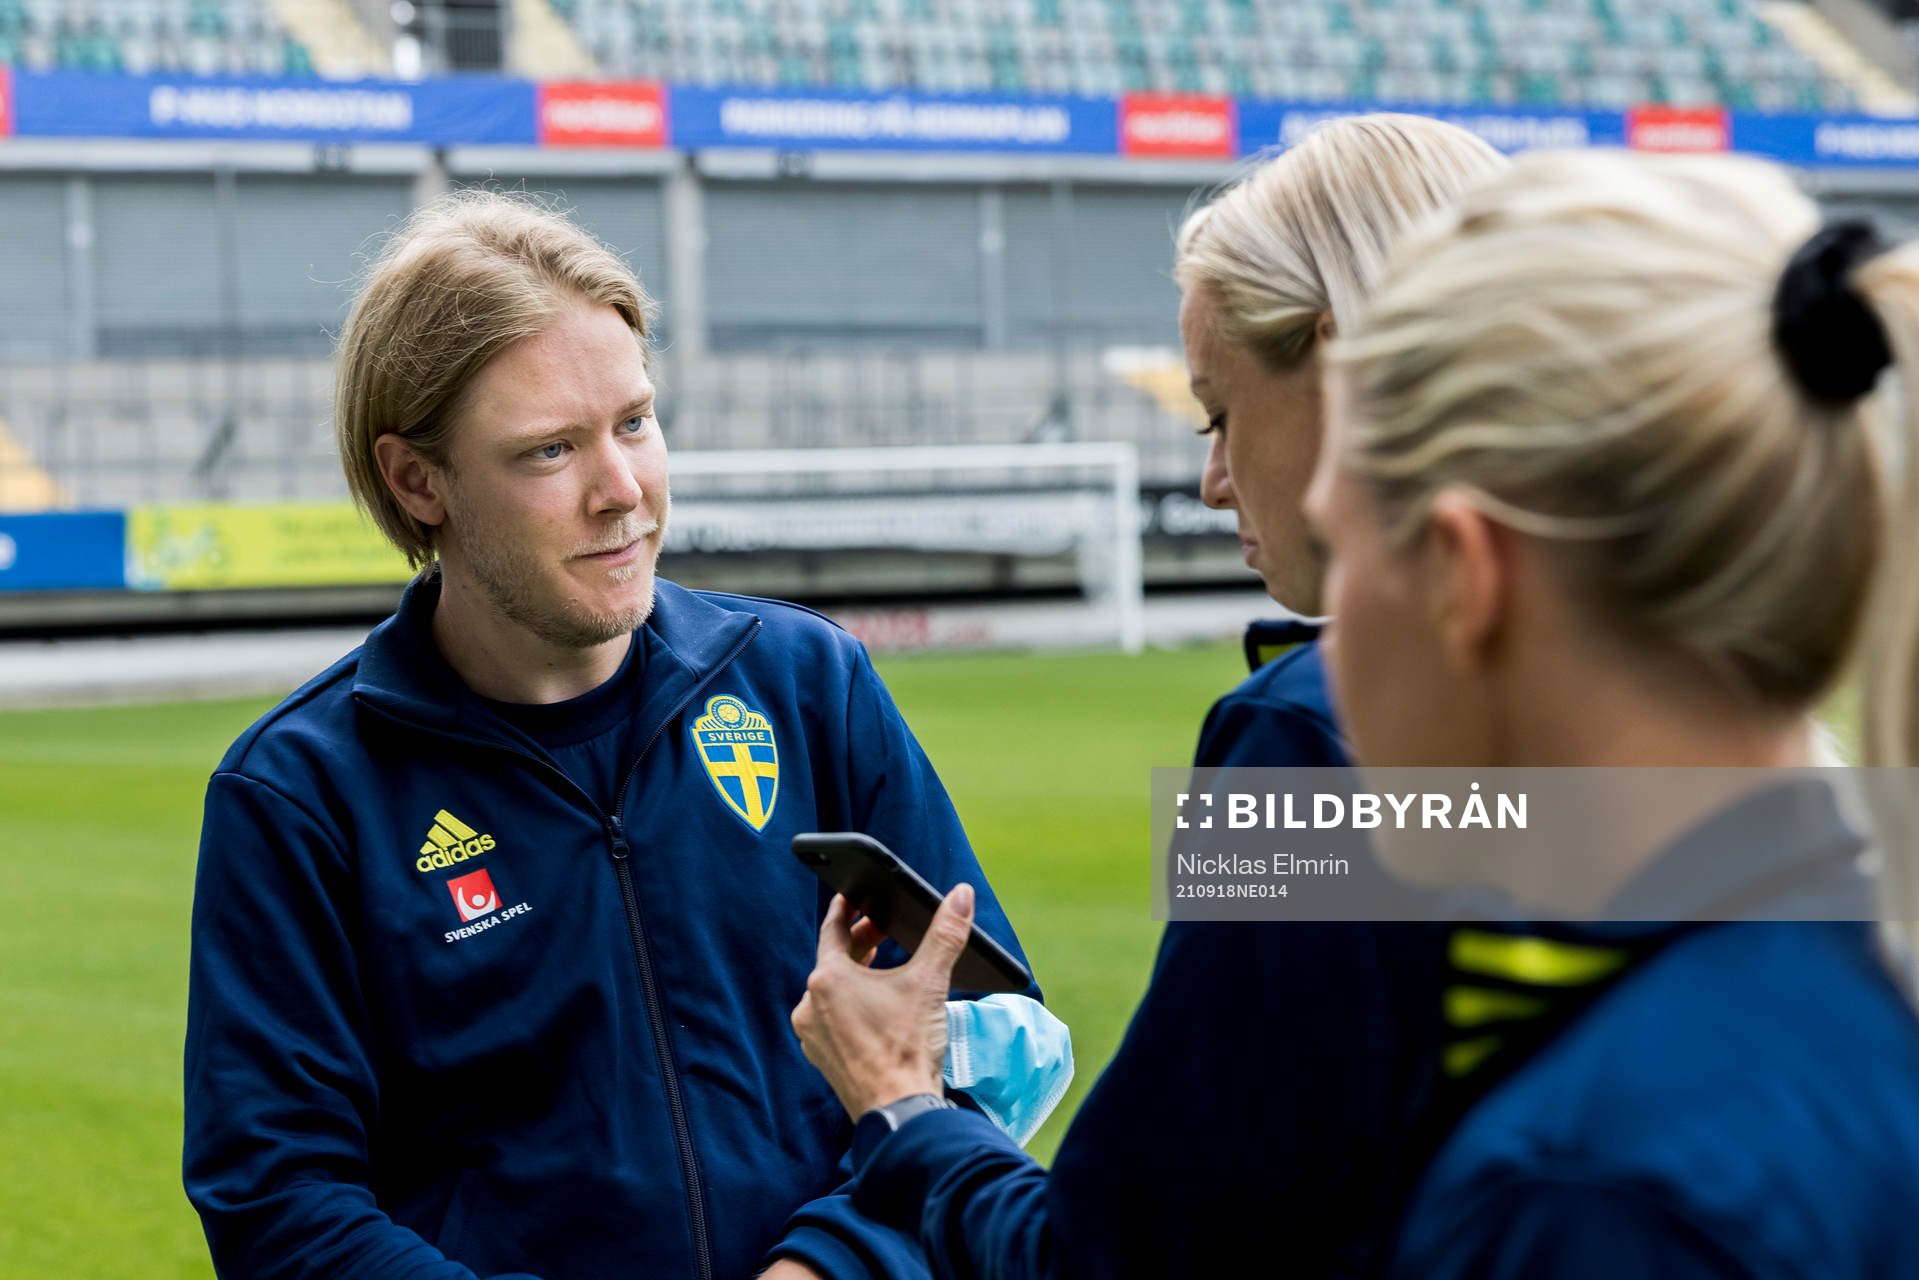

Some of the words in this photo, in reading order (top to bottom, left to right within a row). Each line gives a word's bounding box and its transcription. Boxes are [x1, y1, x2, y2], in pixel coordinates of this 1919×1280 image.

[708, 731, 766, 743] SVERIGE
[416, 834, 496, 873] adidas
[444, 915, 502, 943] SVENSKA
[501, 902, 533, 921] SPEL
